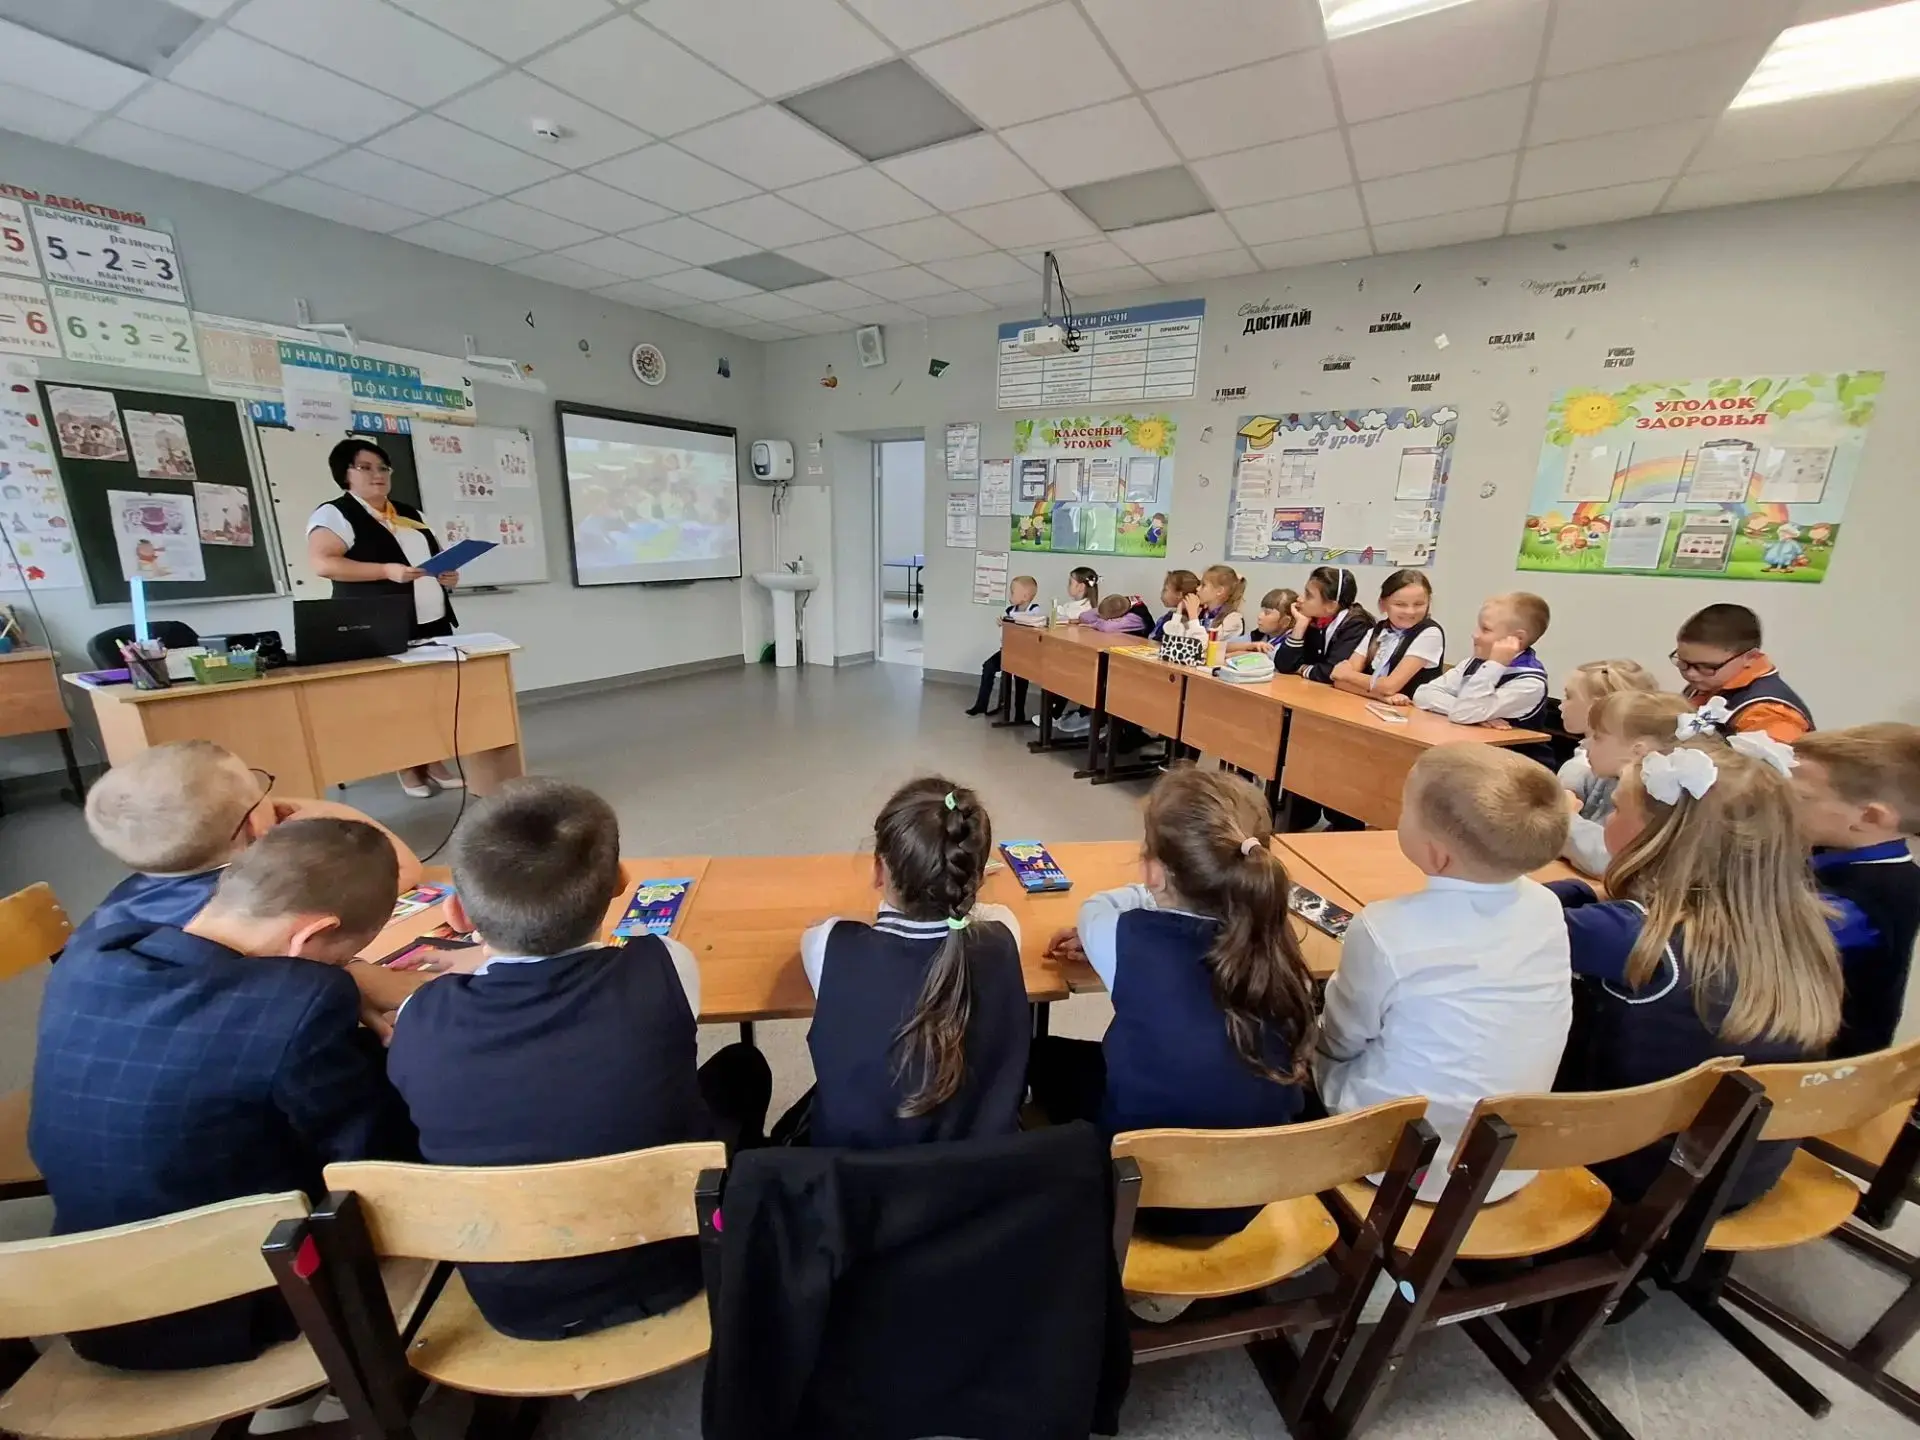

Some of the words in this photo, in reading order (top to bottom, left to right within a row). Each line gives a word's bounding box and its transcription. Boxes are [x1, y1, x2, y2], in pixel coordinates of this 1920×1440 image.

[44, 193, 146, 226] ДЕЙСТВИЙ
[34, 207, 121, 233] ВЫЧИТАНИЕ
[3, 227, 25, 252] 5
[46, 235, 68, 260] 5
[103, 247, 123, 272] 2
[155, 257, 174, 281] 3
[1554, 286, 1576, 298] ДРУГ
[1578, 282, 1606, 295] ДРУГА
[26, 311, 48, 335] 6
[1100, 311, 1128, 327] речи
[1243, 308, 1312, 336] ДОСТИГАЙ!
[1380, 312, 1403, 322] БУДЬ
[67, 315, 88, 339] 6
[120, 324, 140, 346] 3
[172, 331, 190, 353] 2
[1105, 328, 1132, 336] ОТВЕЧАЕТ
[1160, 325, 1190, 333] ПРИМЕРЫ
[1369, 321, 1411, 333] ВЕЖЛИВЫМ
[1109, 333, 1137, 341] ВОПРОСЫ
[1488, 332, 1523, 345] СЛЕДУЙ
[1525, 332, 1535, 341] ЗА
[1655, 397, 1758, 414] УГОЛОК
[1636, 413, 1768, 430] ЗДОРОВЬЯ
[1054, 425, 1124, 439] КЛАССНЫЙ
[1308, 432, 1329, 447] К
[1330, 428, 1385, 450] уроку!
[1064, 439, 1112, 449] УГОЛОК
